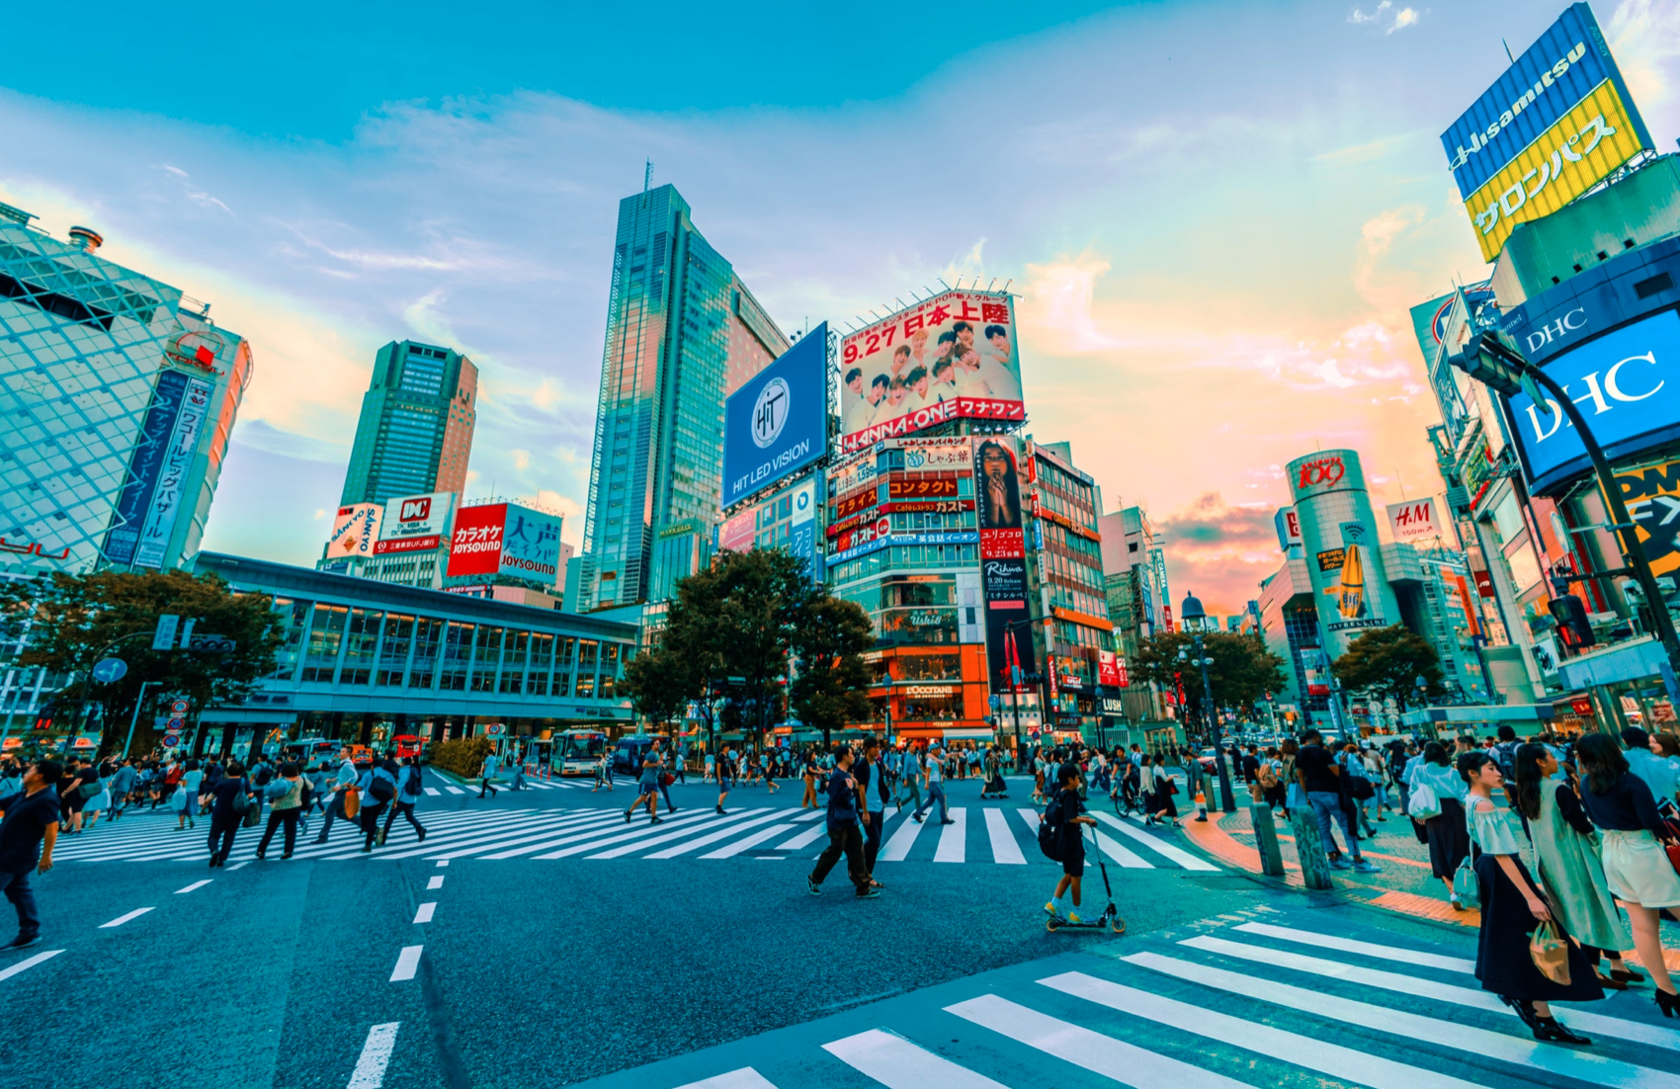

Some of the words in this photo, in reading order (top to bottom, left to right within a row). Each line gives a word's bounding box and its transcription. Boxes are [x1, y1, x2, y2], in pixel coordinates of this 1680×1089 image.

[1448, 41, 1587, 171] Hisamitsu
[1474, 114, 1617, 236] サロンパス
[843, 325, 897, 365] 9.27
[904, 300, 1010, 340] 日本上陸
[1525, 307, 1588, 354] DHC
[1525, 350, 1666, 445] DHC
[960, 401, 1021, 416] ワナワン
[896, 436, 967, 448] しゃぶしゃぶバイキング
[733, 473, 749, 494] HIT
[750, 462, 771, 484] LED
[771, 438, 810, 470] VISION
[927, 450, 970, 464] しゃぶ葉
[1297, 463, 1345, 489] 109
[829, 481, 838, 492] 9F
[890, 480, 956, 494] コンタクト
[402, 500, 428, 519] DC
[936, 501, 968, 513] ガスト
[1395, 502, 1430, 527] H&M
[859, 508, 880, 525] ガスト
[331, 509, 365, 543] SANKYO
[359, 508, 376, 552] SANKYO
[455, 525, 502, 543] カラオケ
[506, 515, 560, 545] 大声
[981, 529, 1022, 541] ユリゴコロ
[452, 540, 501, 554] JOYSOUND
[829, 541, 838, 552] 7F
[850, 528, 876, 548] ガスト
[918, 534, 978, 543] 英会話イーオン
[501, 554, 556, 575] JOYSOUND
[984, 561, 1023, 576] Rihwa
[906, 685, 953, 694] L'OCCITANE
[1102, 698, 1122, 711] LUSH
